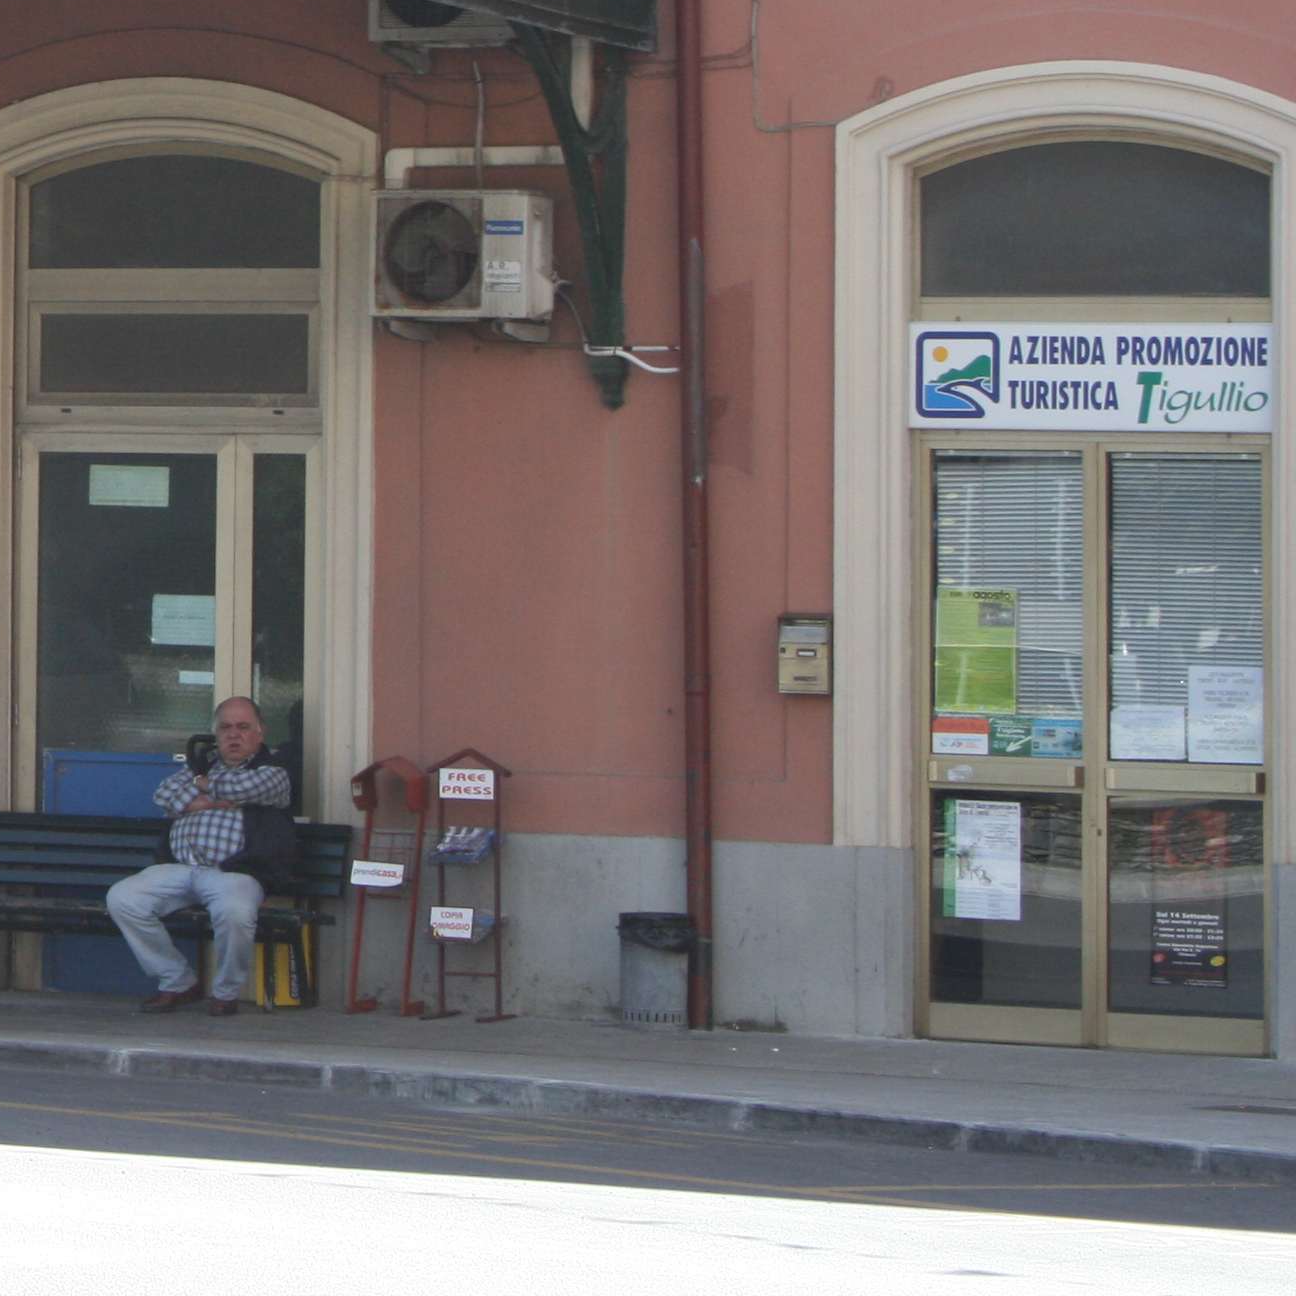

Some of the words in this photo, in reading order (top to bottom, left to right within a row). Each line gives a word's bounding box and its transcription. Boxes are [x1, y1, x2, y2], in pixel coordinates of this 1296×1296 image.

[1008, 336, 1105, 365] AZIENDA
[1116, 337, 1268, 366] PROMOZIONE
[1008, 380, 1119, 410] TURISTICA
[1136, 371, 1269, 424] Tigullio
[448, 772, 487, 782] FREE
[441, 785, 492, 795] PRESS
